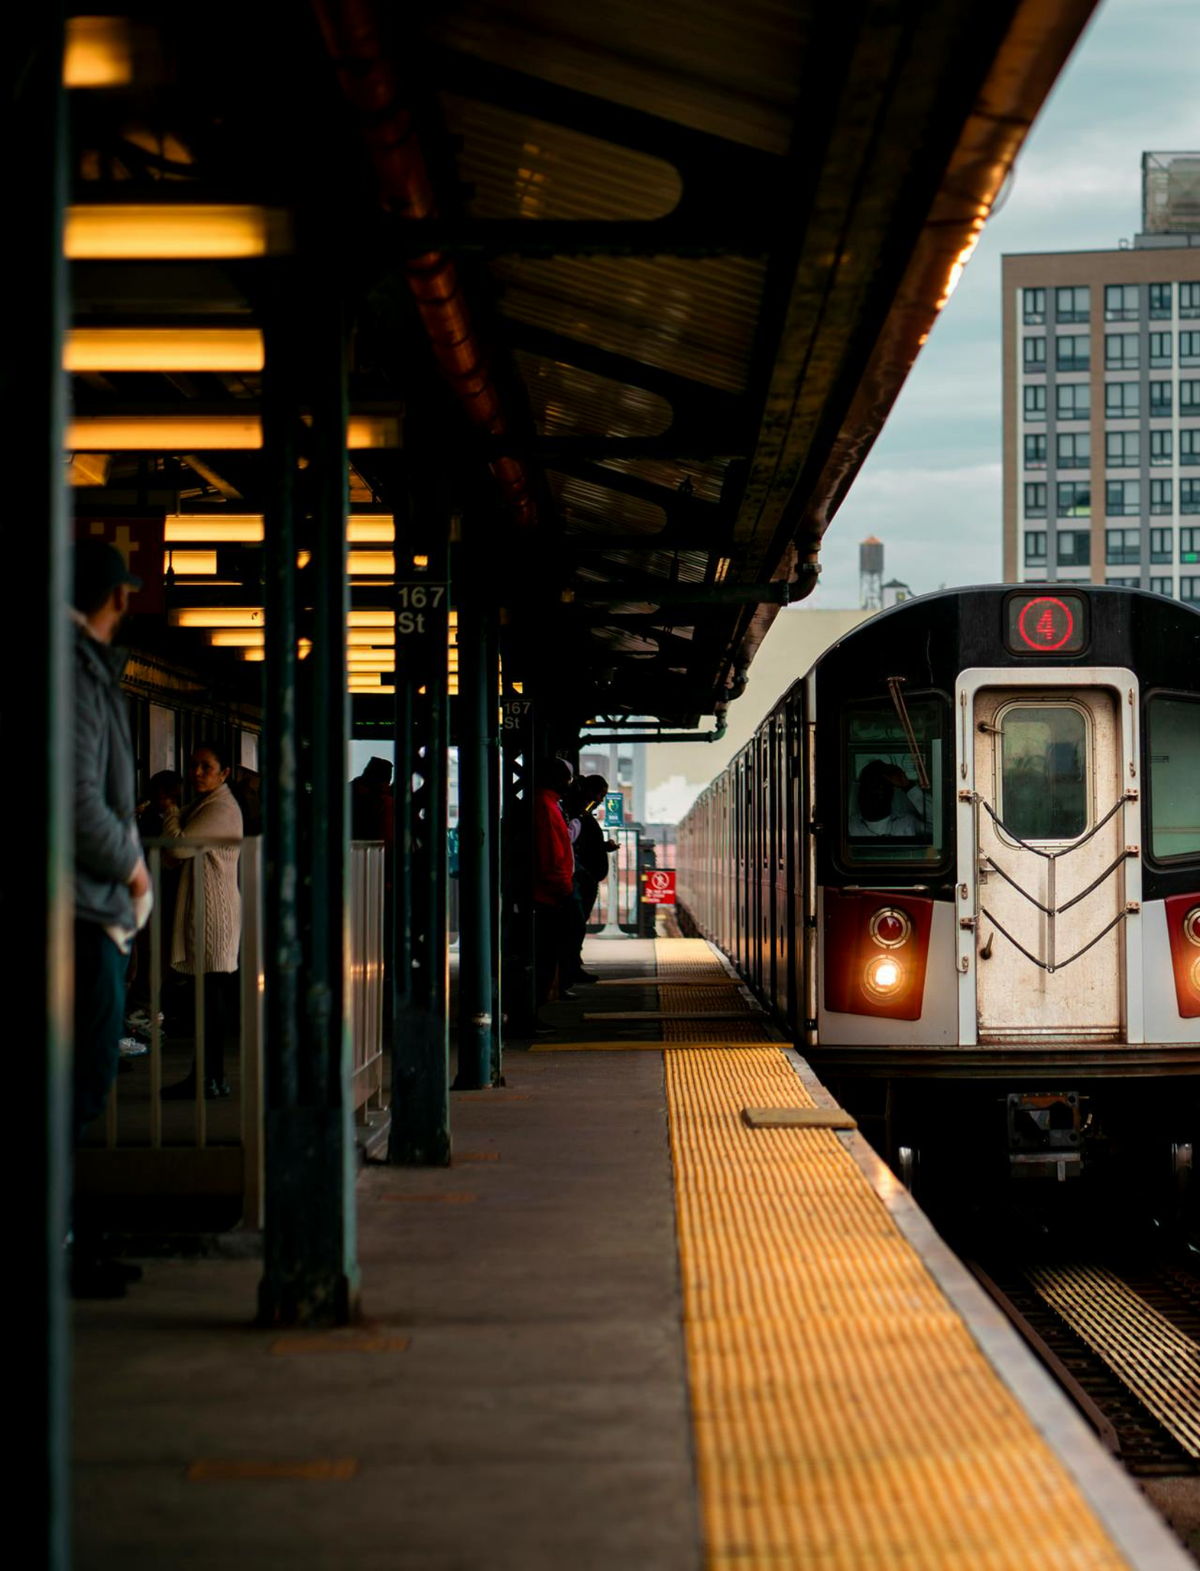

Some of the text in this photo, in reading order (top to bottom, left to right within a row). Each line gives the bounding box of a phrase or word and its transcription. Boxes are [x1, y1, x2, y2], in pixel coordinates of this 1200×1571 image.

[398, 586, 445, 608] 167
[398, 612, 425, 634] St
[1036, 609, 1056, 640] 4
[503, 701, 531, 715] 167
[504, 716, 521, 729] St
